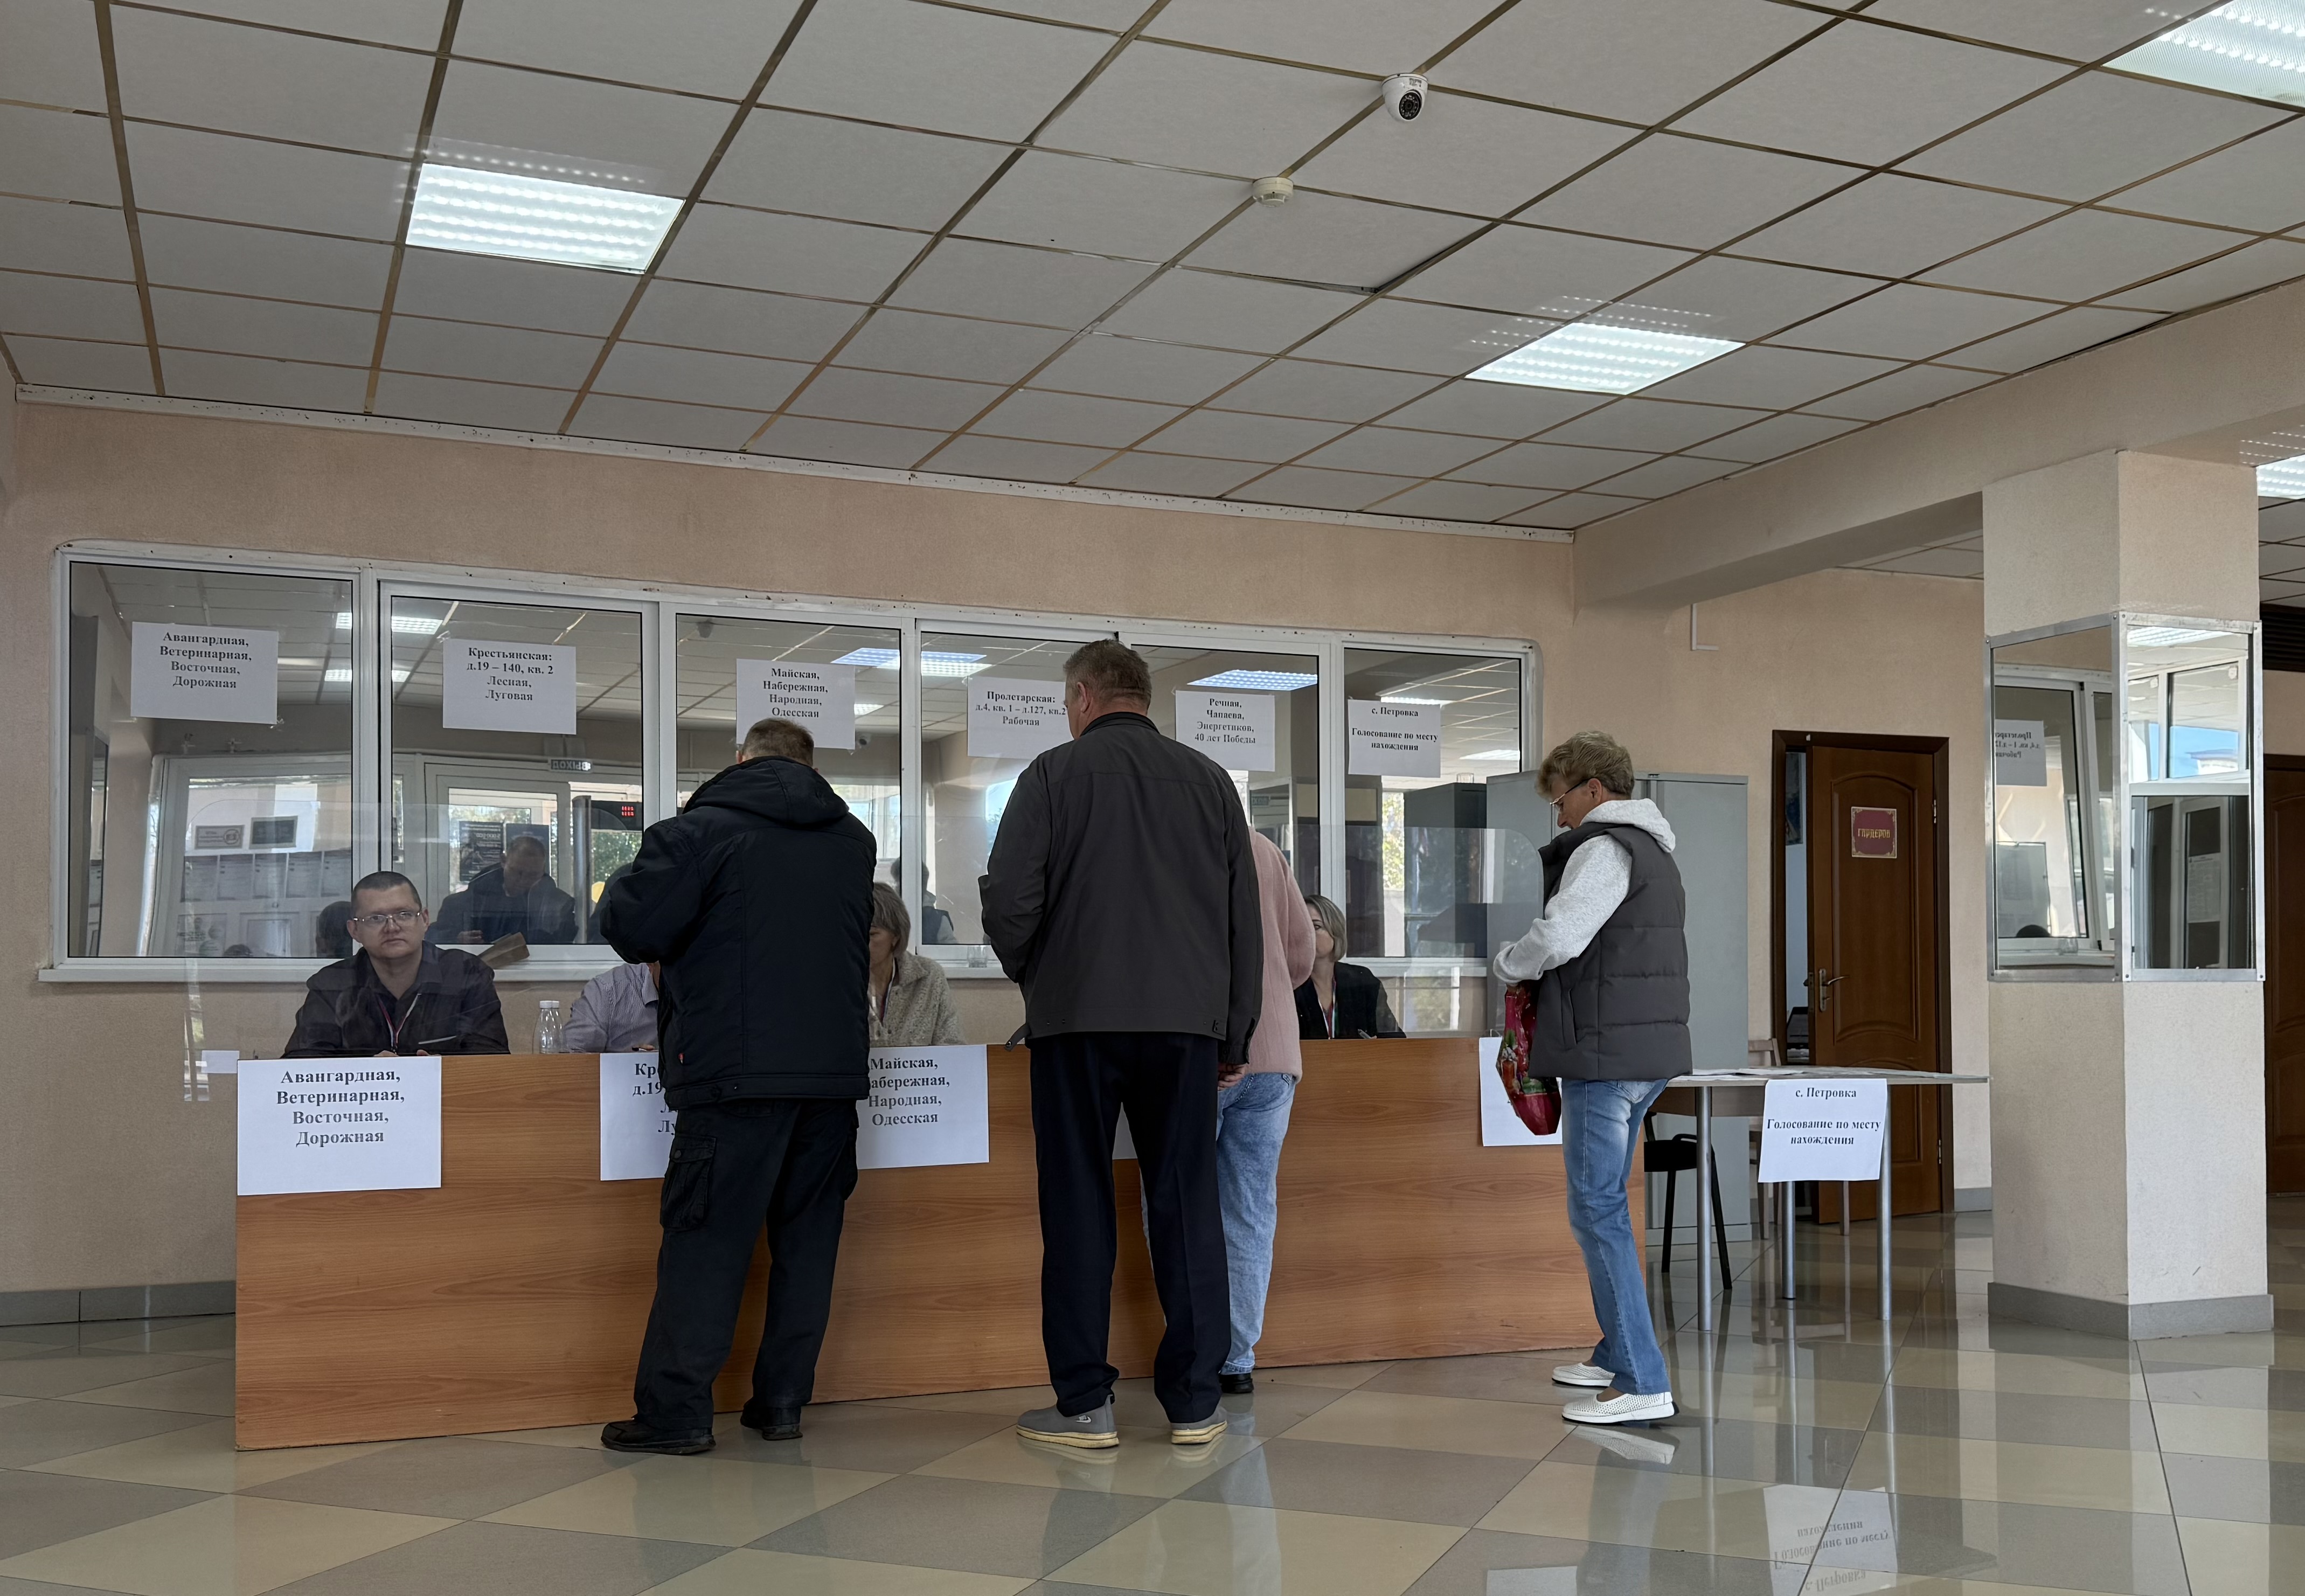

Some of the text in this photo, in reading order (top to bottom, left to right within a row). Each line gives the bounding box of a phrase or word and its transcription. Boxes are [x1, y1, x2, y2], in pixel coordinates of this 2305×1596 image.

[163, 632, 249, 647] Авангардная,
[160, 646, 252, 661] Ветеринарная,
[468, 648, 552, 661] Крестьянская:
[171, 661, 240, 675] Восточная,
[467, 662, 489, 670] д.19
[503, 663, 524, 674] 140,
[527, 666, 544, 674] кв.
[548, 665, 553, 674] 2
[772, 668, 820, 680] Майская,
[173, 676, 236, 688] Дорожная
[487, 676, 531, 688] Лесная,
[763, 681, 828, 693] Набережная,
[485, 690, 533, 701] Луговая
[769, 694, 822, 706] Народная,
[987, 691, 1056, 704] Пролетарская:
[1210, 698, 1242, 708] Речная,
[772, 707, 819, 718] Одесская
[1022, 706, 1046, 715] д.127,
[1207, 710, 1245, 720] Чапаева,
[1380, 707, 1418, 717] Петровка
[1003, 716, 1039, 726] Рабочая
[1197, 721, 1254, 733] Энергетиков,
[1224, 734, 1255, 744] Победы
[1352, 728, 1402, 739] Голосование
[1416, 734, 1438, 743] месту
[1371, 743, 1418, 751] нахождения
[870, 1058, 938, 1070] Майская,
[280, 1071, 400, 1085] Авангардная,
[871, 1077, 950, 1091] абережная,
[276, 1091, 405, 1106] Ветеринарная,
[1807, 1087, 1856, 1100] Петровка
[869, 1095, 941, 1109] Народная,
[293, 1111, 388, 1124] Восточная,
[872, 1114, 938, 1126] Одесская
[1767, 1119, 1881, 1132] Голосование по месту
[296, 1132, 384, 1148] Дорожная
[1791, 1136, 1854, 1145] нахождения
